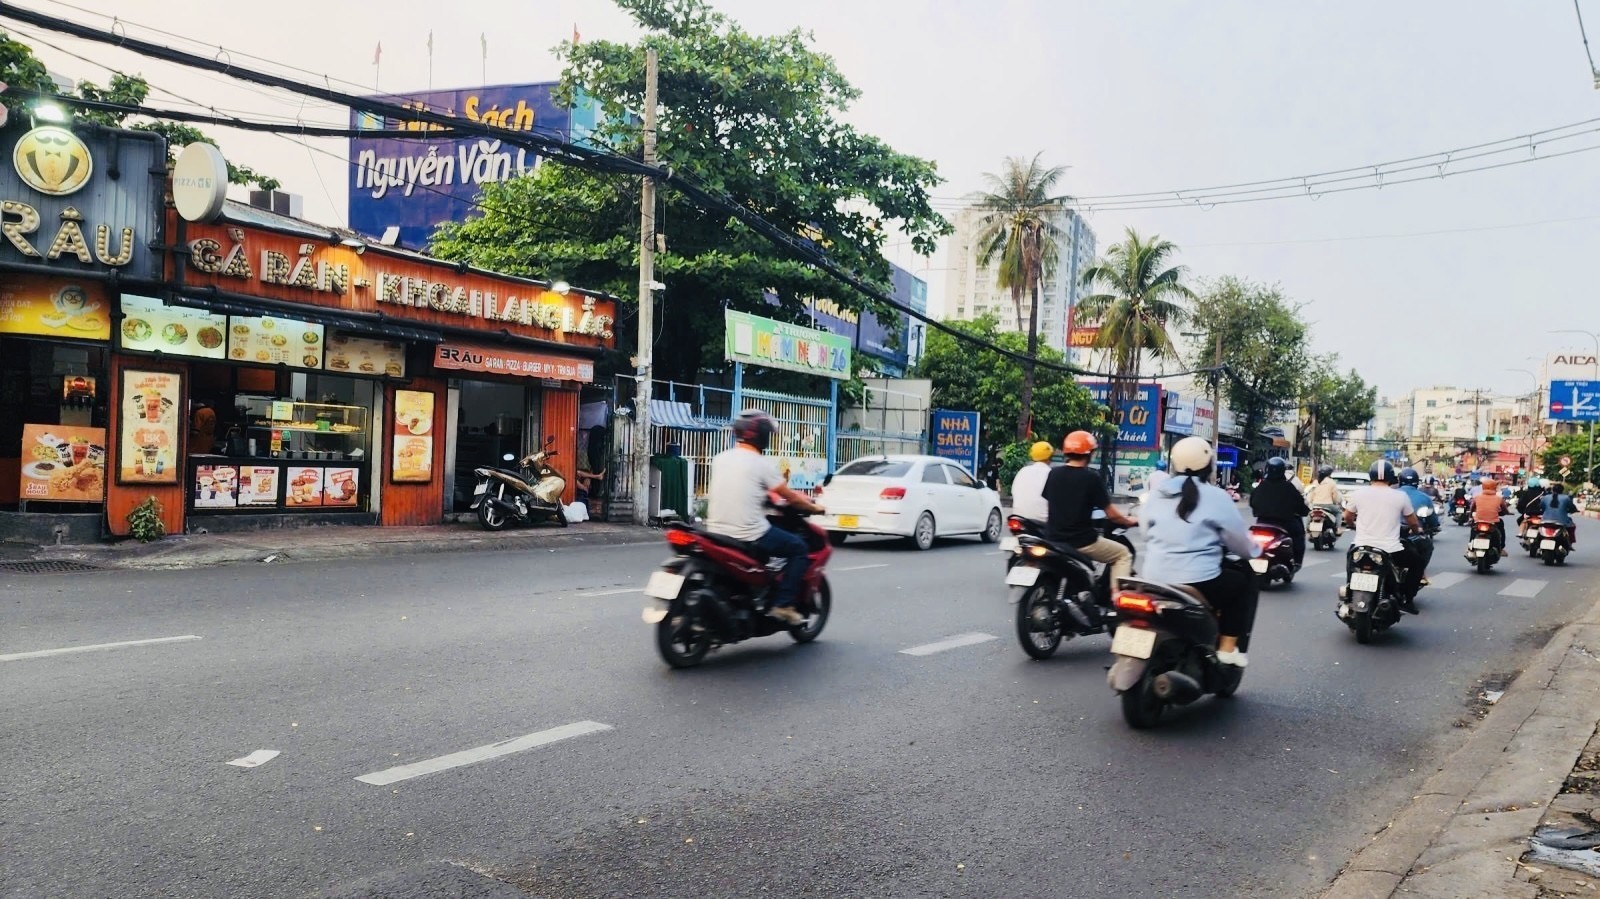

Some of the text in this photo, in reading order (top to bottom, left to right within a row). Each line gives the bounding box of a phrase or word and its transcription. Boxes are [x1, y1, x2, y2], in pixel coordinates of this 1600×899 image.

[466, 96, 535, 132] Sách
[357, 145, 455, 199] Nguyễn
[459, 139, 511, 184] Văn
[0, 200, 135, 266] RÂU
[187, 227, 253, 279] GÀ
[260, 243, 348, 295] RÁN
[376, 272, 483, 318] KHOAI
[484, 290, 562, 330] LANG
[563, 295, 614, 339] LẮC
[831, 347, 846, 371] 26
[941, 416, 971, 431] NHÀ
[1129, 405, 1150, 425] Cừ
[937, 431, 973, 447] SÁCH
[1116, 431, 1148, 442] Khách
